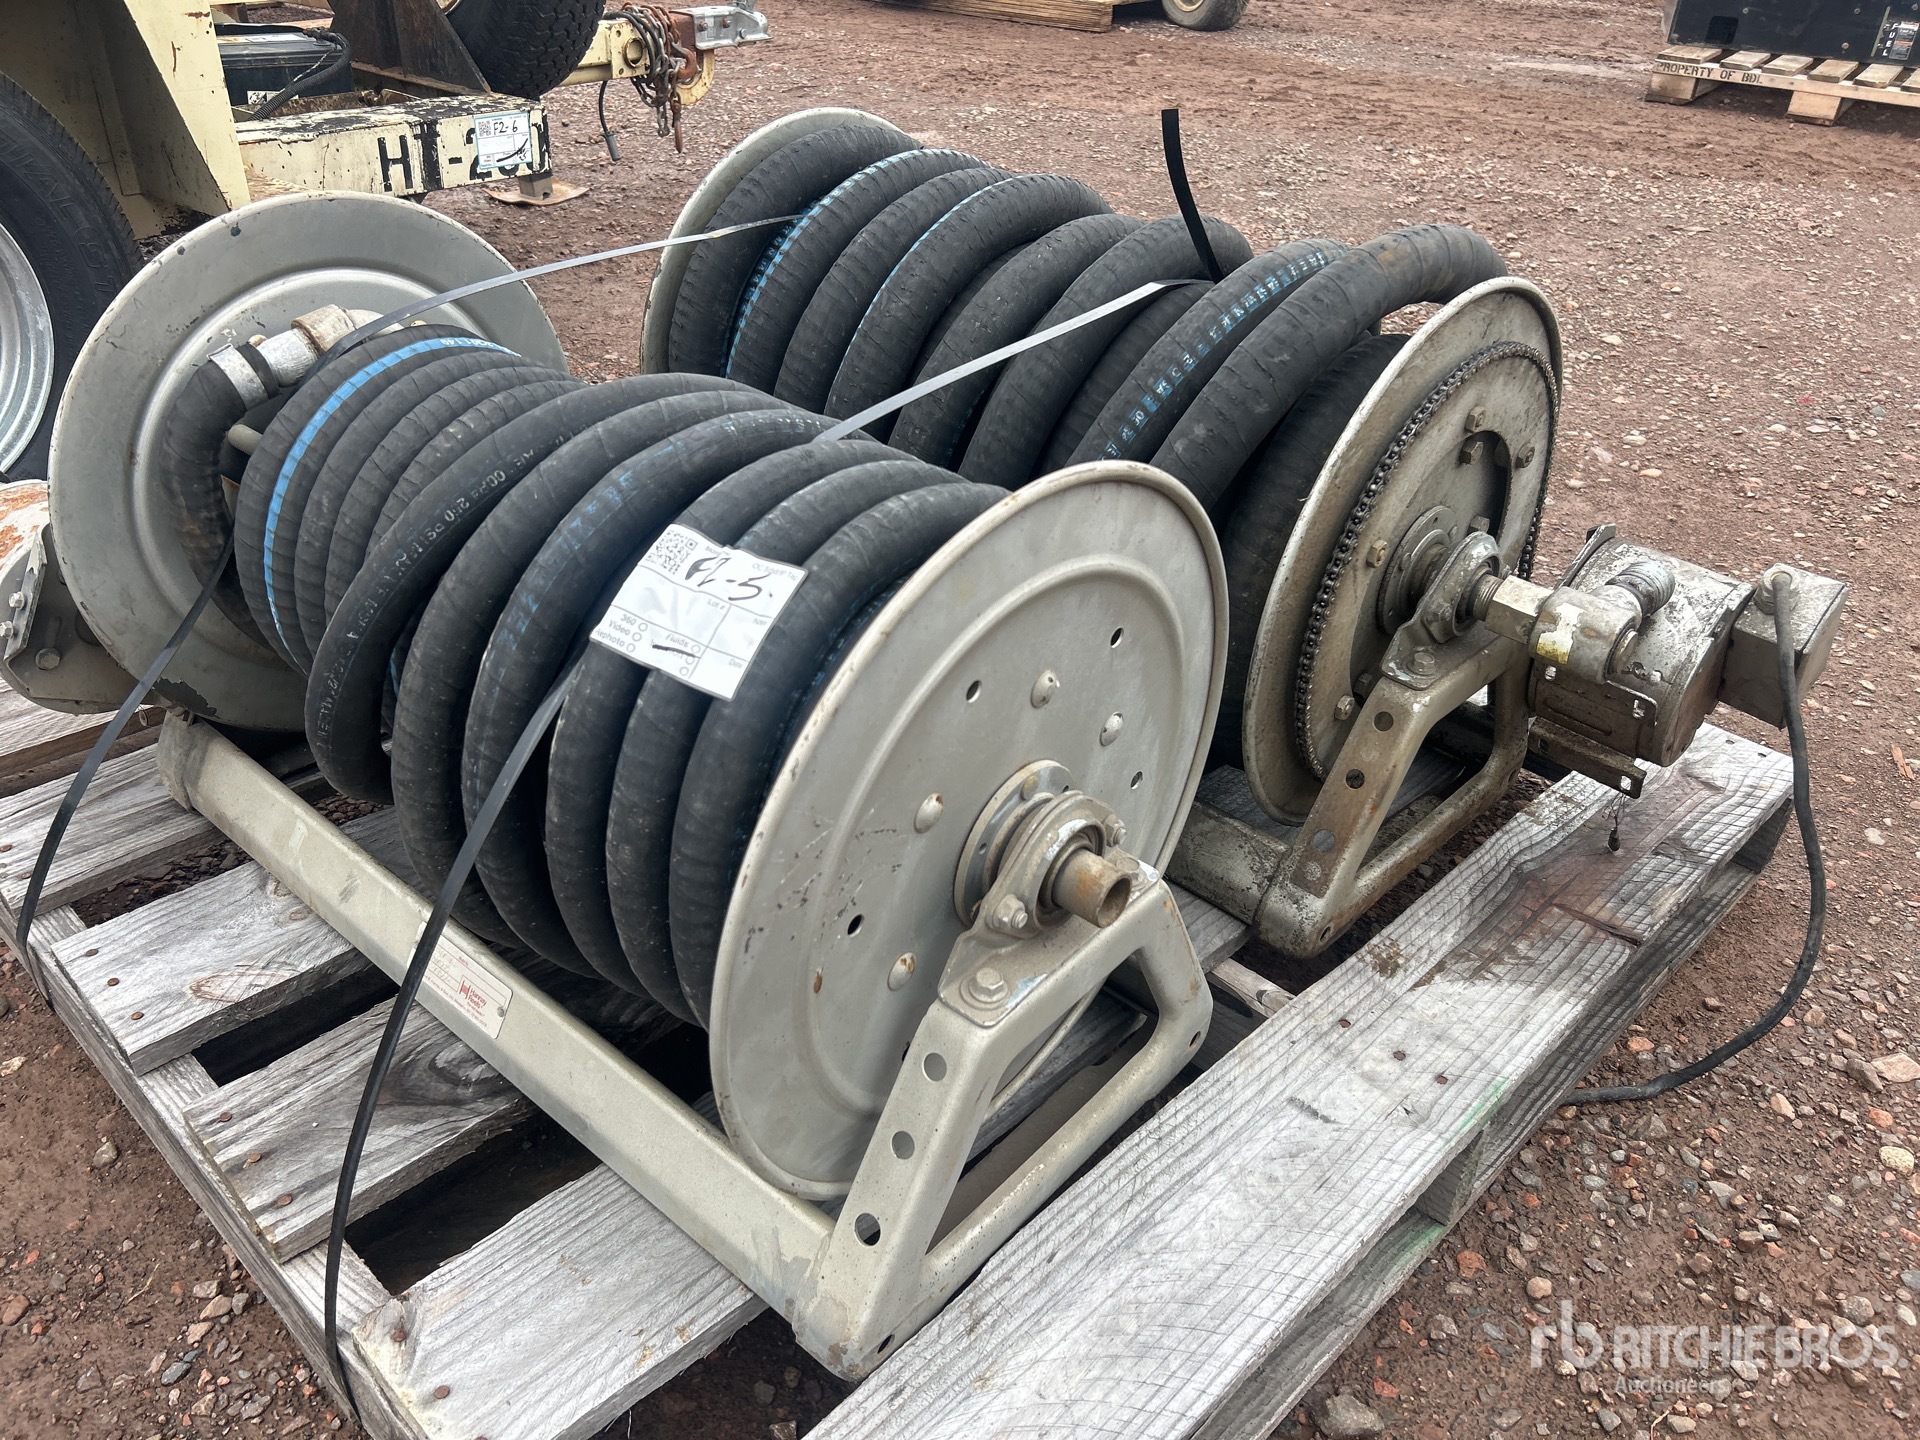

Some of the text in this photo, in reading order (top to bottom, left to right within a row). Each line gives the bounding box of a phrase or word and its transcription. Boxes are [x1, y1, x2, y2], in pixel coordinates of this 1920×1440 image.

[1657, 61, 1714, 79] PROPERTY
[1720, 70, 1736, 81] OF
[608, 619, 631, 636] Video
[620, 613, 637, 626] 360
[665, 633, 689, 649] Fluids
